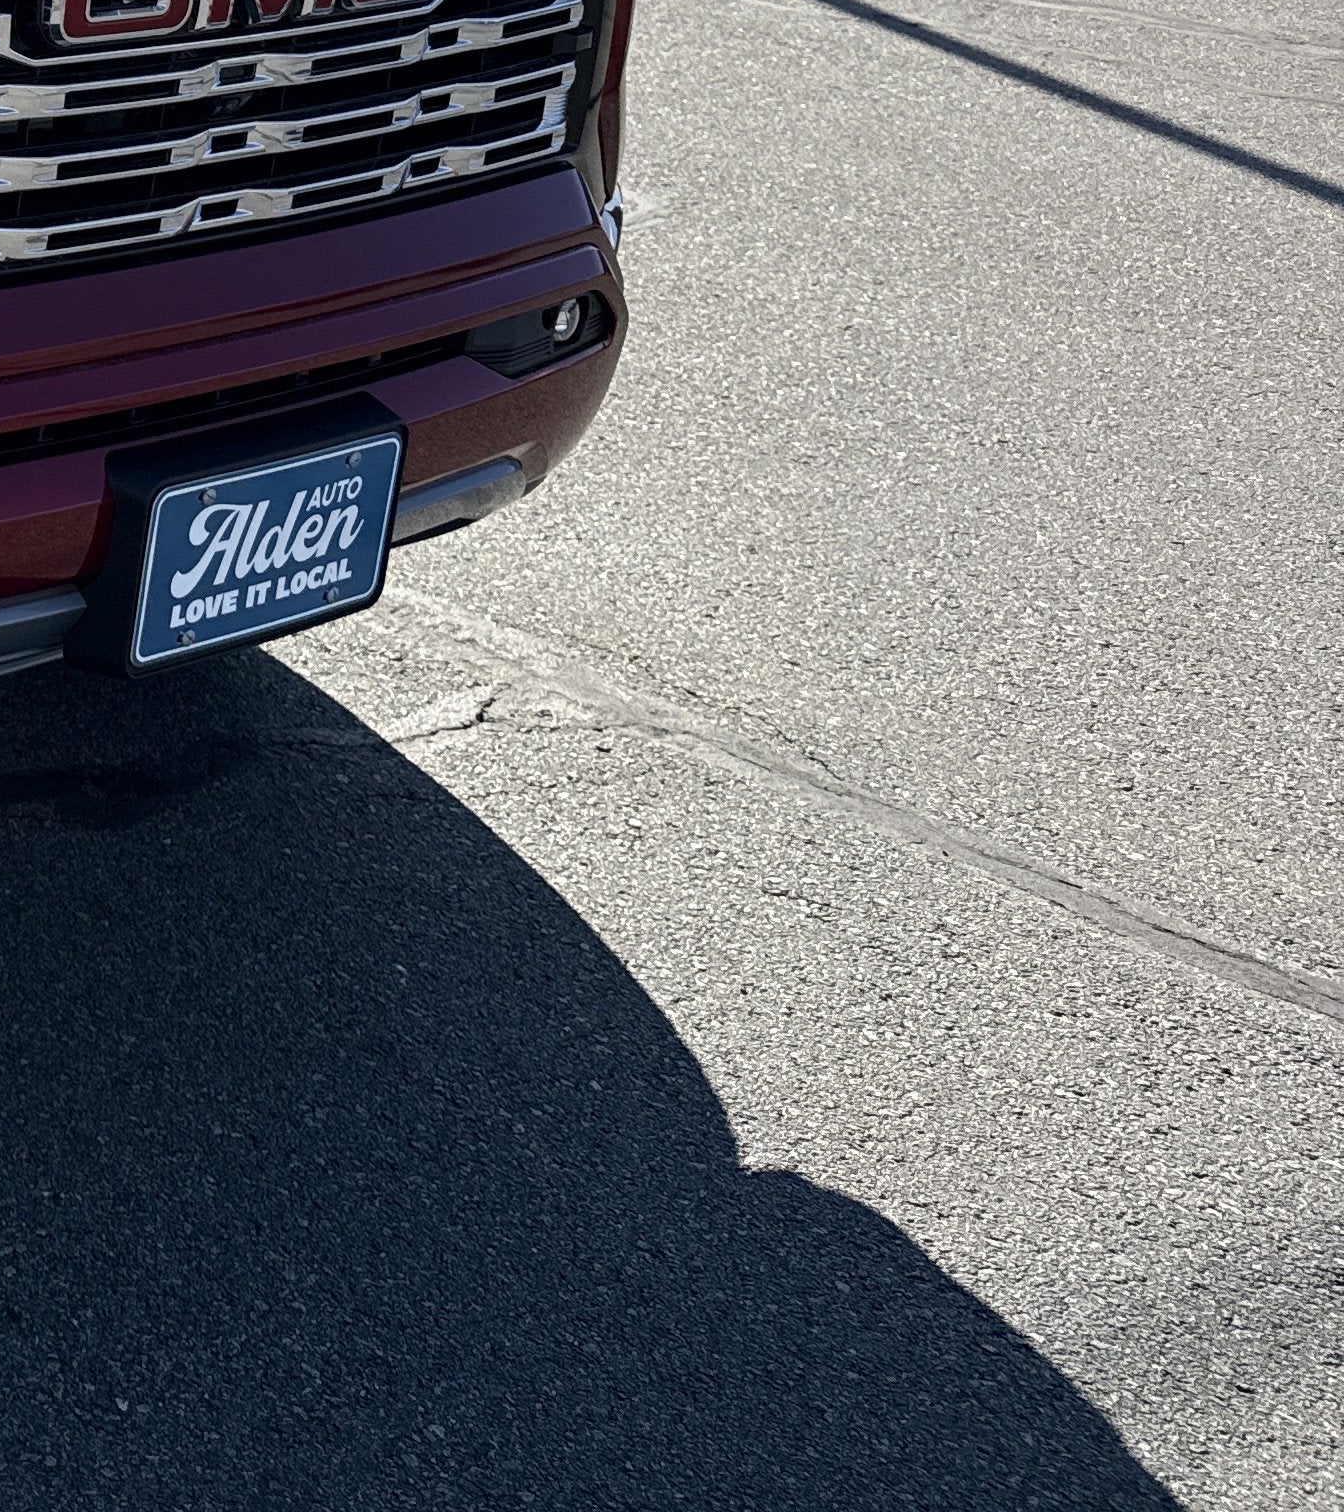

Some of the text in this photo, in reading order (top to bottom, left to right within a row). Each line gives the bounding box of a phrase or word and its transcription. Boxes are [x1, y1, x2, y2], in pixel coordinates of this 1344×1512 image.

[306, 475, 363, 512] AUTO
[170, 490, 365, 599] Alden
[169, 558, 352, 628] LOVE IT LOCAL
